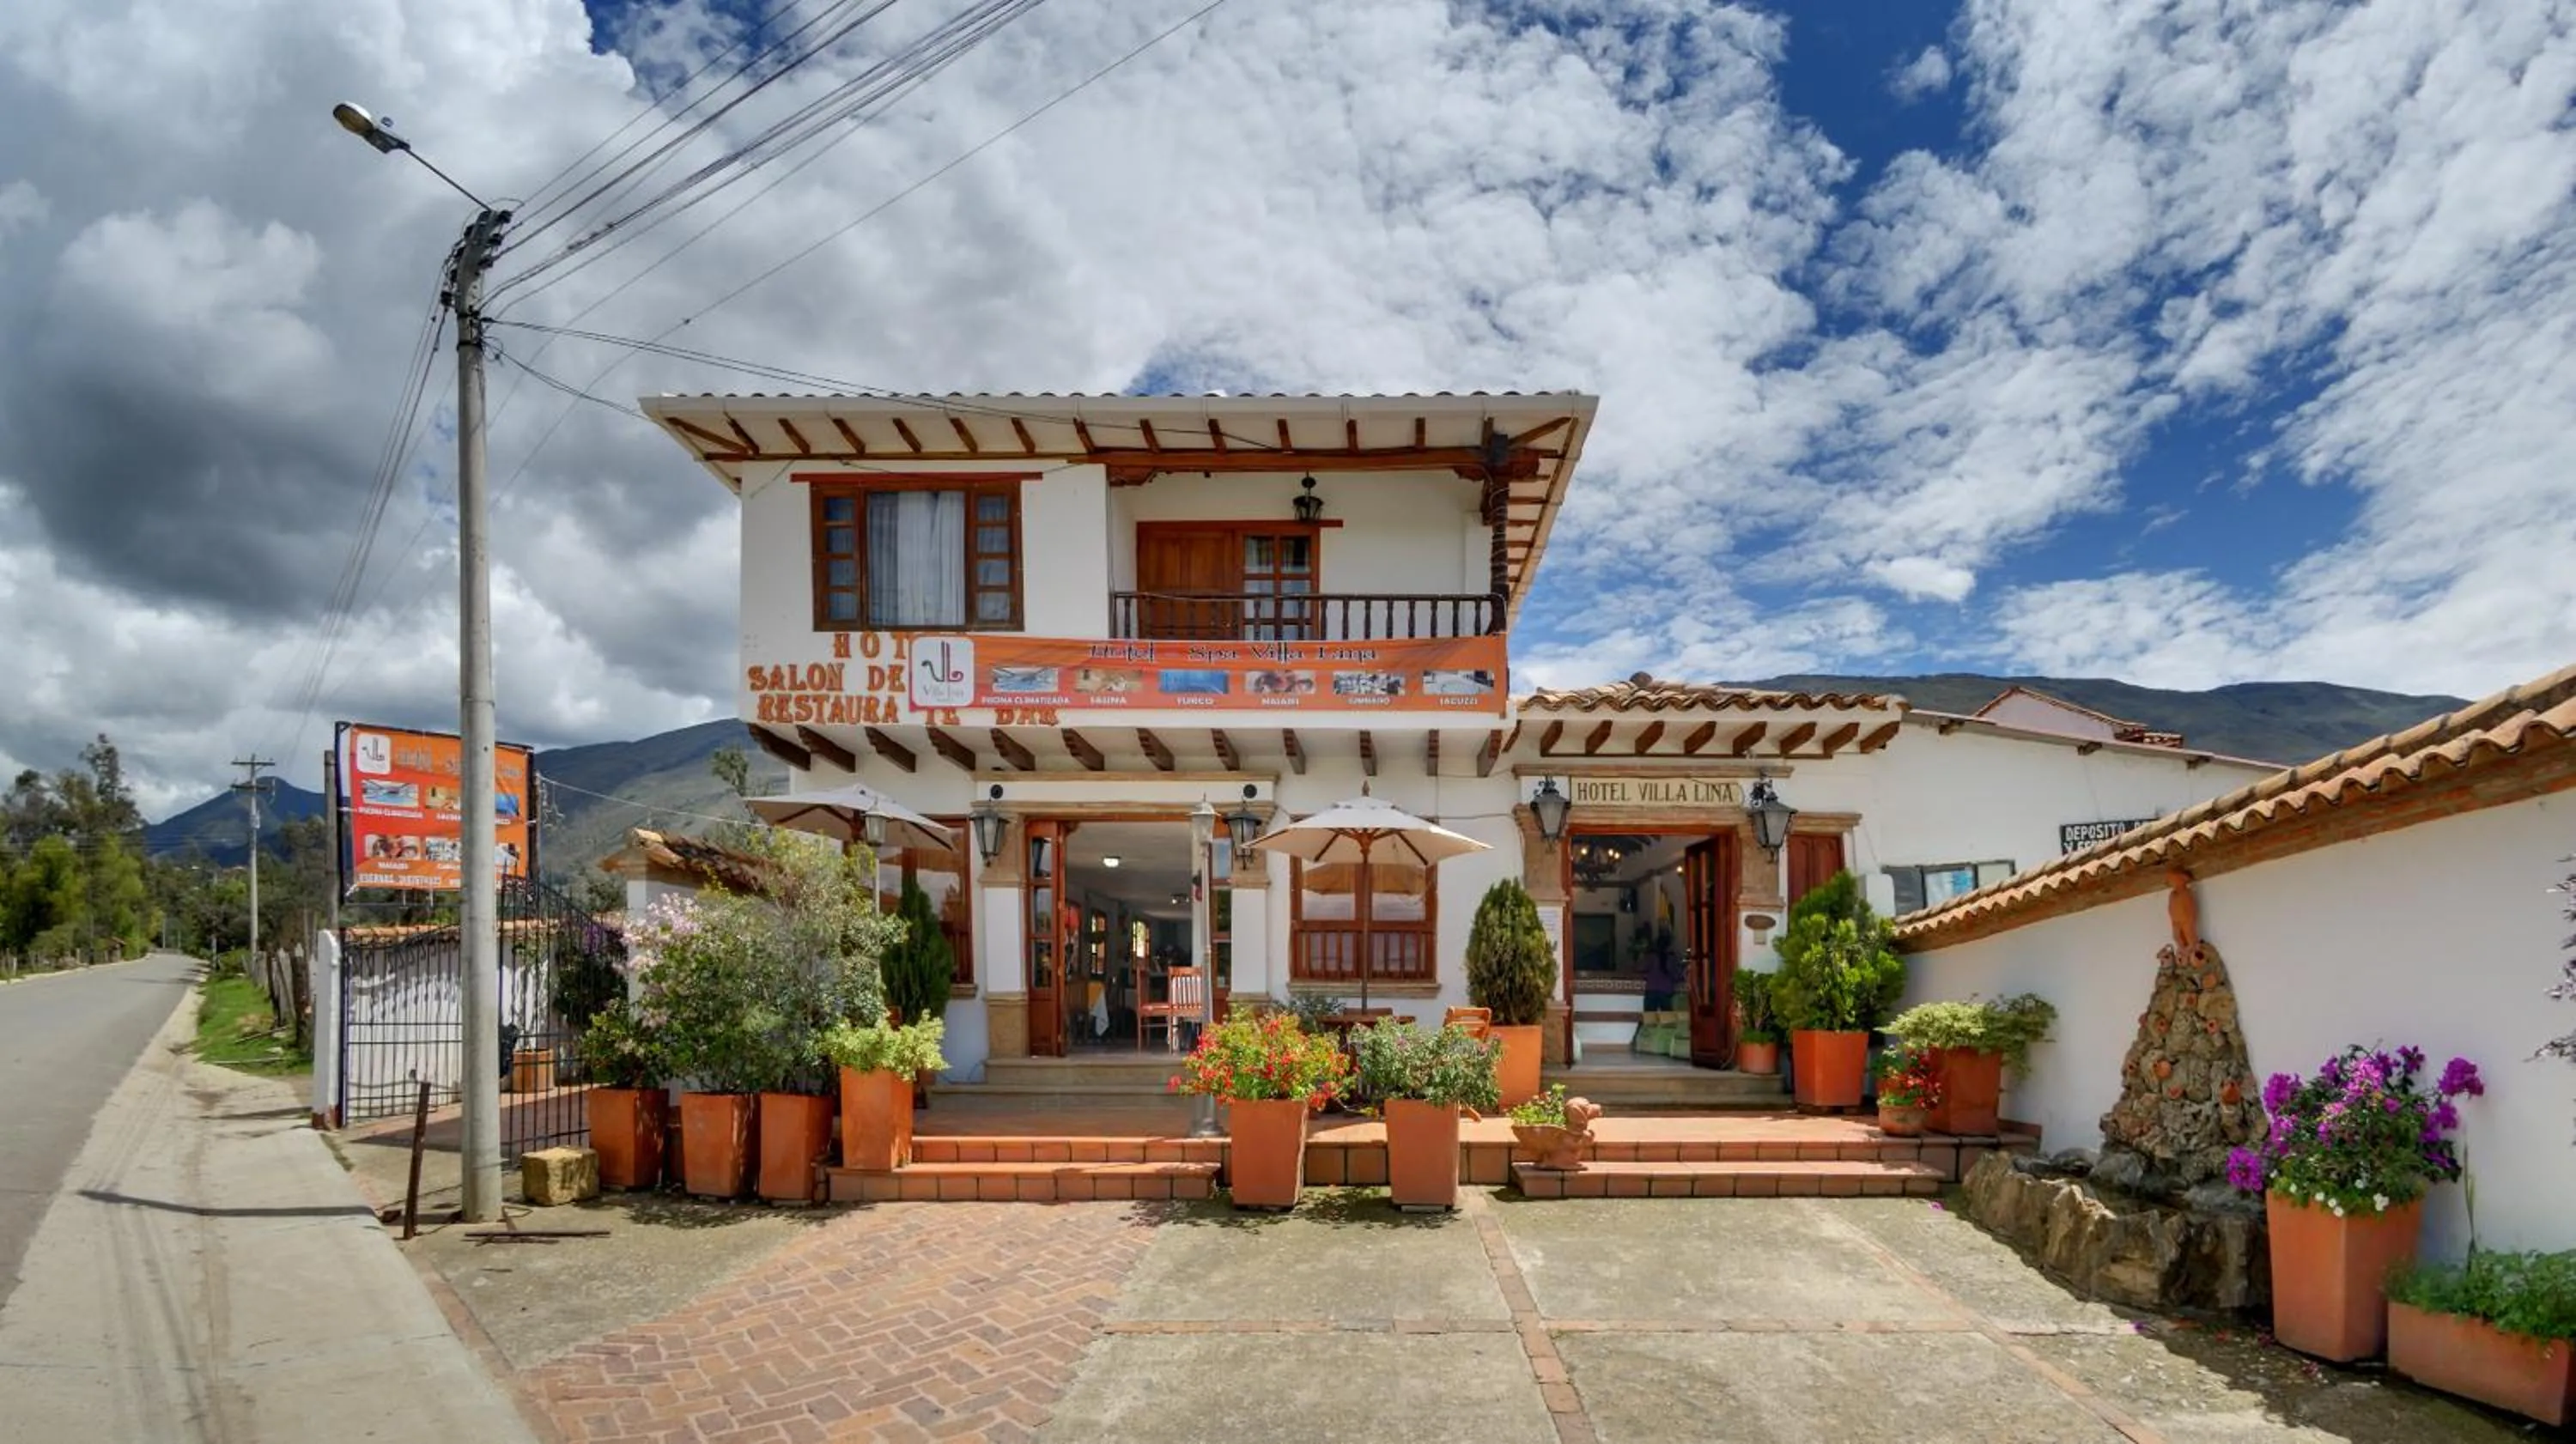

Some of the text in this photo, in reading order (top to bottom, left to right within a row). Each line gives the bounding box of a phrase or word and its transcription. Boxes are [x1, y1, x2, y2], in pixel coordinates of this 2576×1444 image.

[748, 662, 907, 693] SALON DE
[1577, 781, 1735, 803] HOTEL VILLA LINA
[2065, 821, 2125, 841] DEPOSITO
